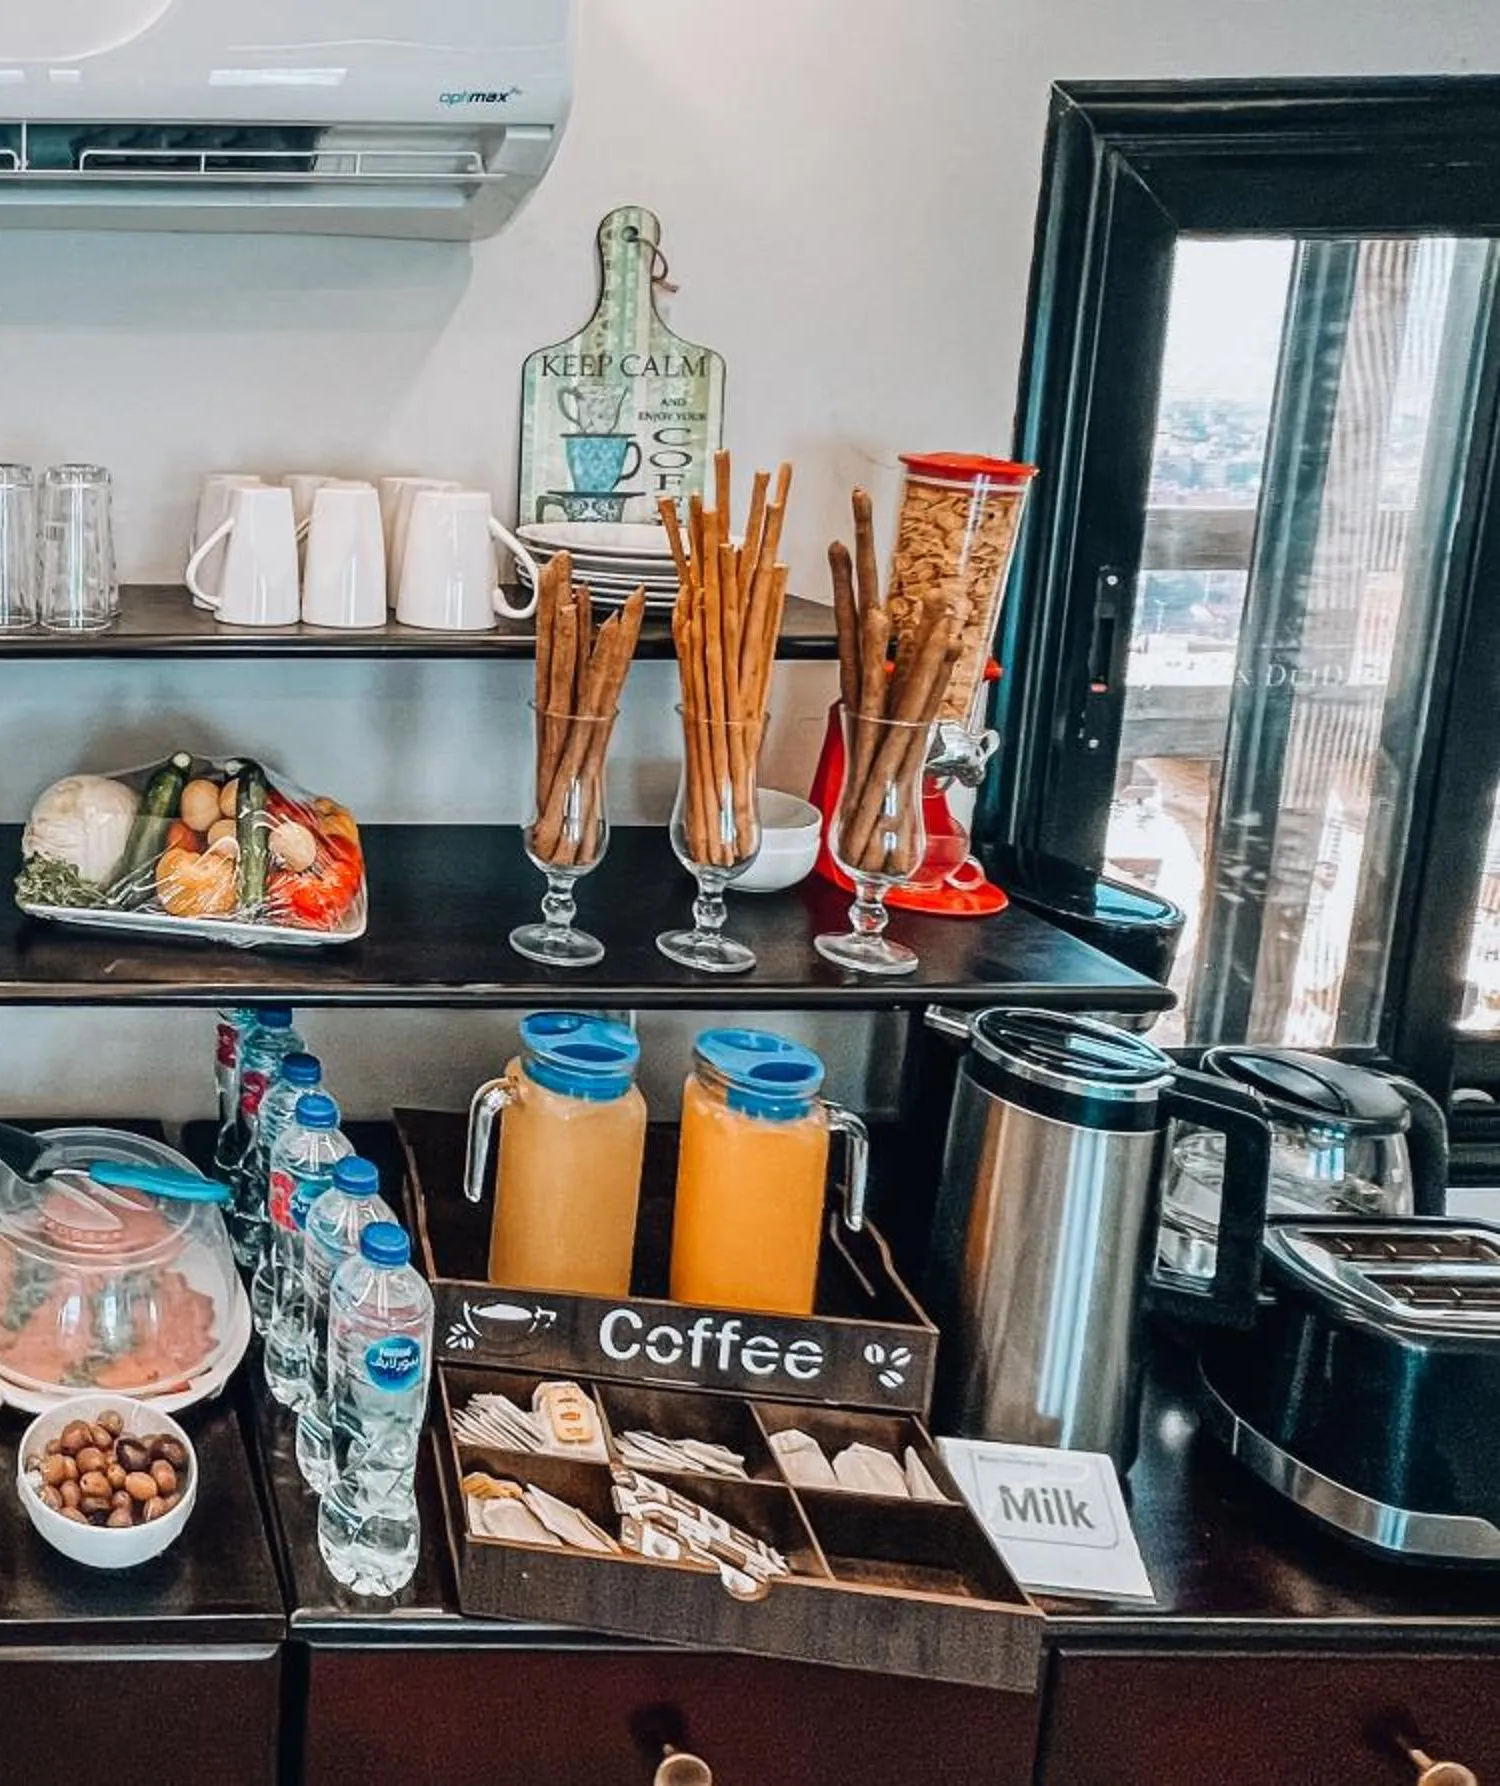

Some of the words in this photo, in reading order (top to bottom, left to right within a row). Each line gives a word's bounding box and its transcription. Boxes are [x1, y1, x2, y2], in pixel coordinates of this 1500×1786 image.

[541, 354, 613, 377] KEEP
[619, 353, 709, 377] CALM
[660, 398, 688, 407] AND
[600, 1308, 824, 1380] Coffee
[998, 1484, 1096, 1530] Milk
